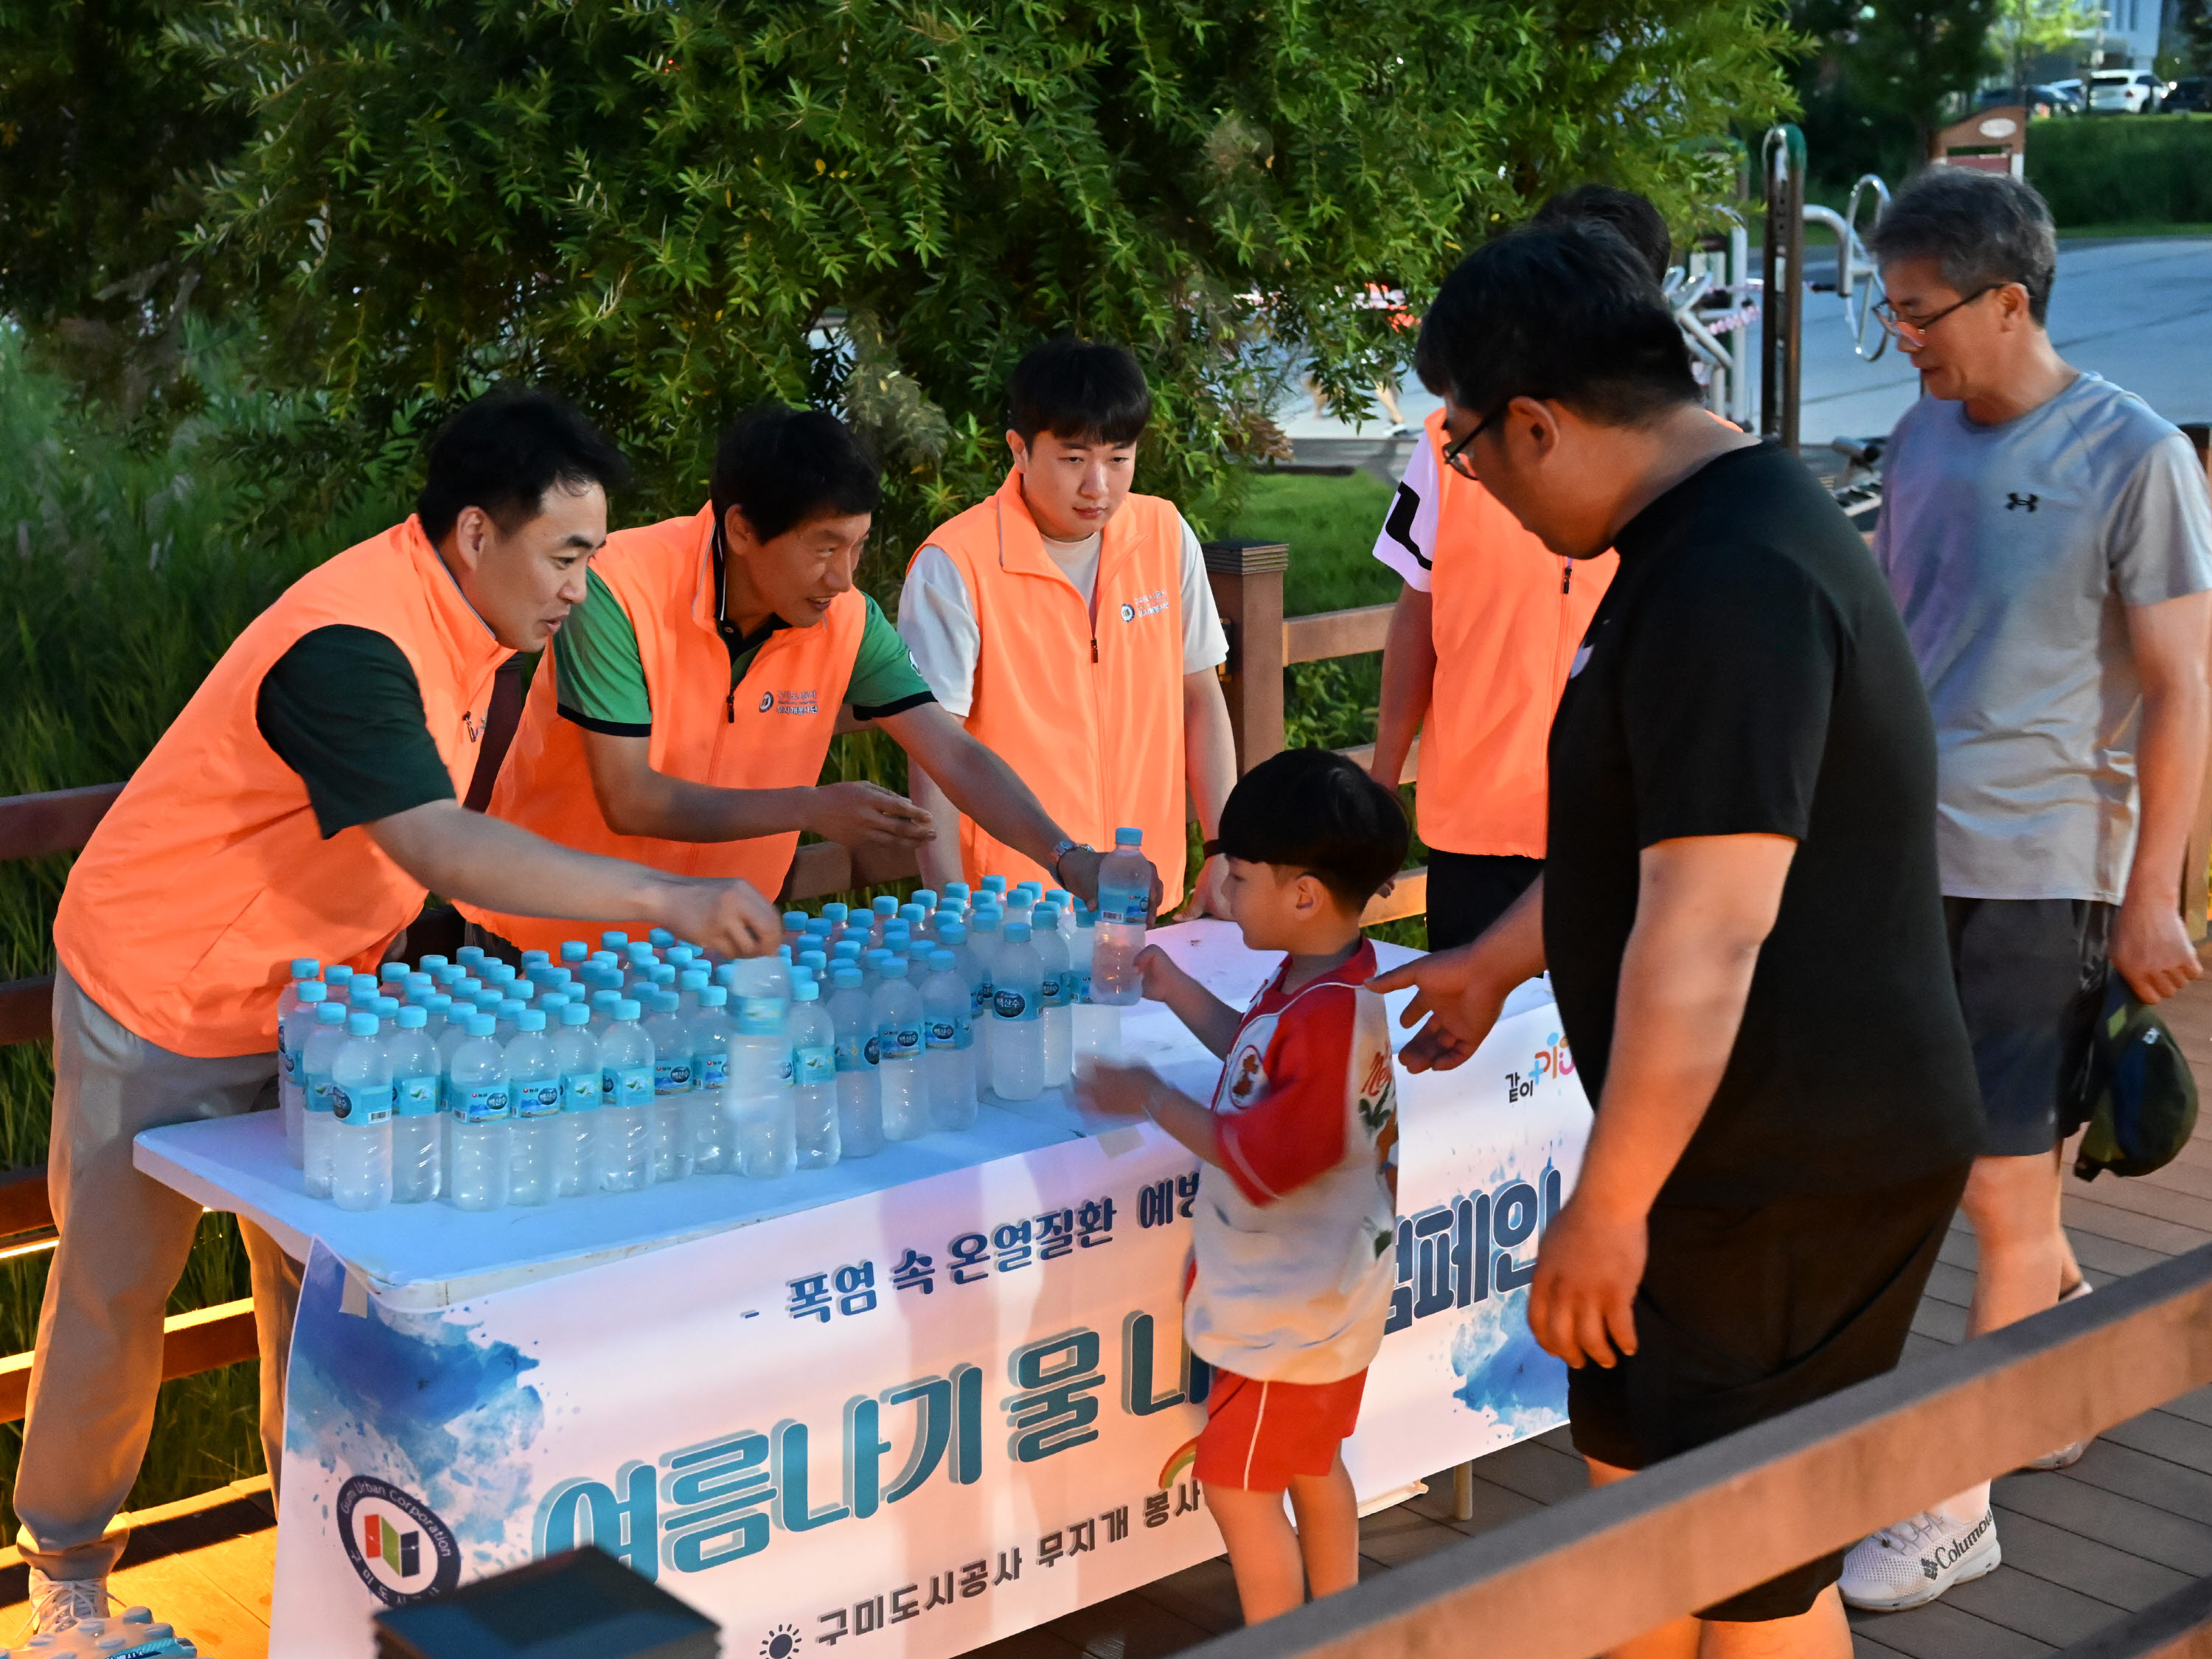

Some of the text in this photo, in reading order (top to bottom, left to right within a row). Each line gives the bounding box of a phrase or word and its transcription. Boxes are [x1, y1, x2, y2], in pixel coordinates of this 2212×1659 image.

[776, 705, 818, 716] 무지개봉사단
[996, 997, 1020, 1008] 백산수
[1505, 1071, 1534, 1104] 같이
[785, 1260, 877, 1324] 폭염
[890, 1248, 936, 1295] 속
[947, 1197, 1118, 1285] 온열질환
[530, 1363, 984, 1584] 여름나기
[1007, 1326, 1106, 1464] 물
[355, 1480, 387, 1496] Urban
[389, 1489, 451, 1558] Corporation
[815, 1545, 1023, 1647] 구미도시공사
[1035, 1503, 1130, 1569] 무지개
